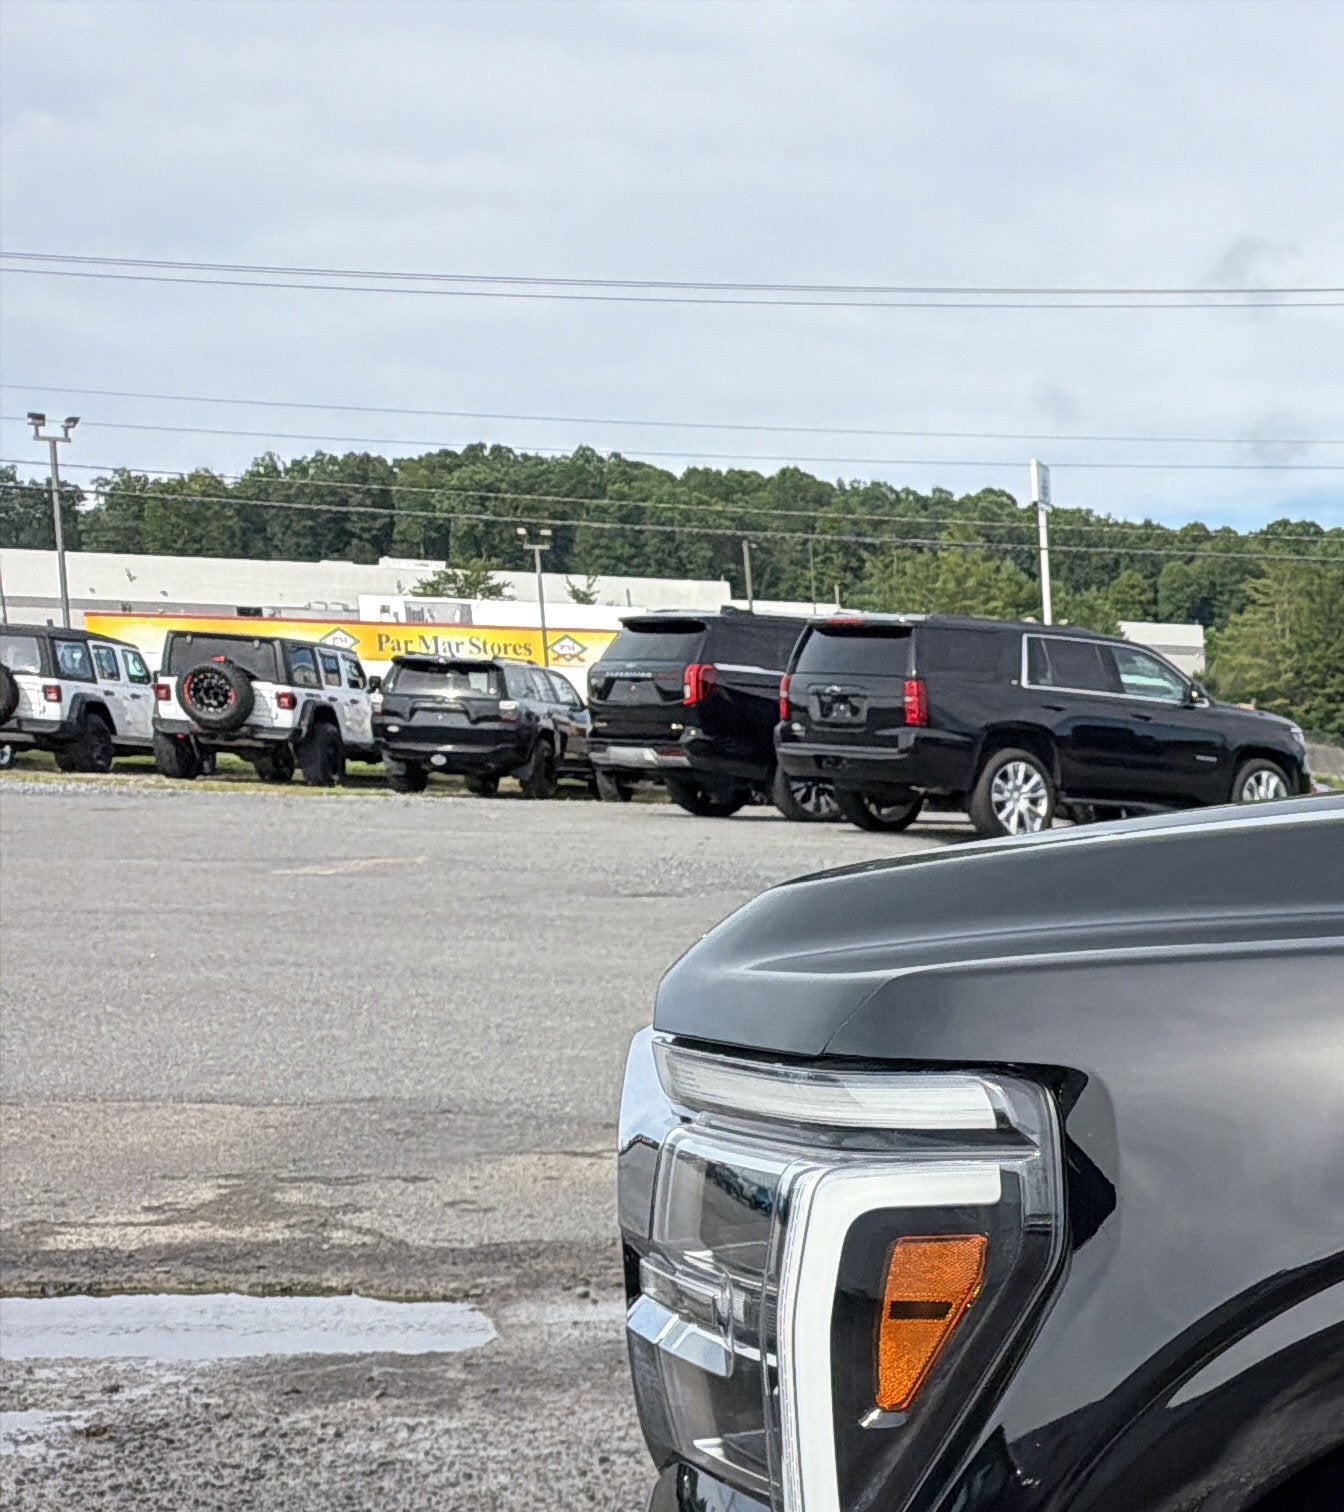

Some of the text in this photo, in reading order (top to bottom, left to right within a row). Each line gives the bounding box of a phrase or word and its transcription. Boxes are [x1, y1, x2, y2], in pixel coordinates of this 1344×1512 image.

[377, 633, 533, 657] Par Mar Stores
